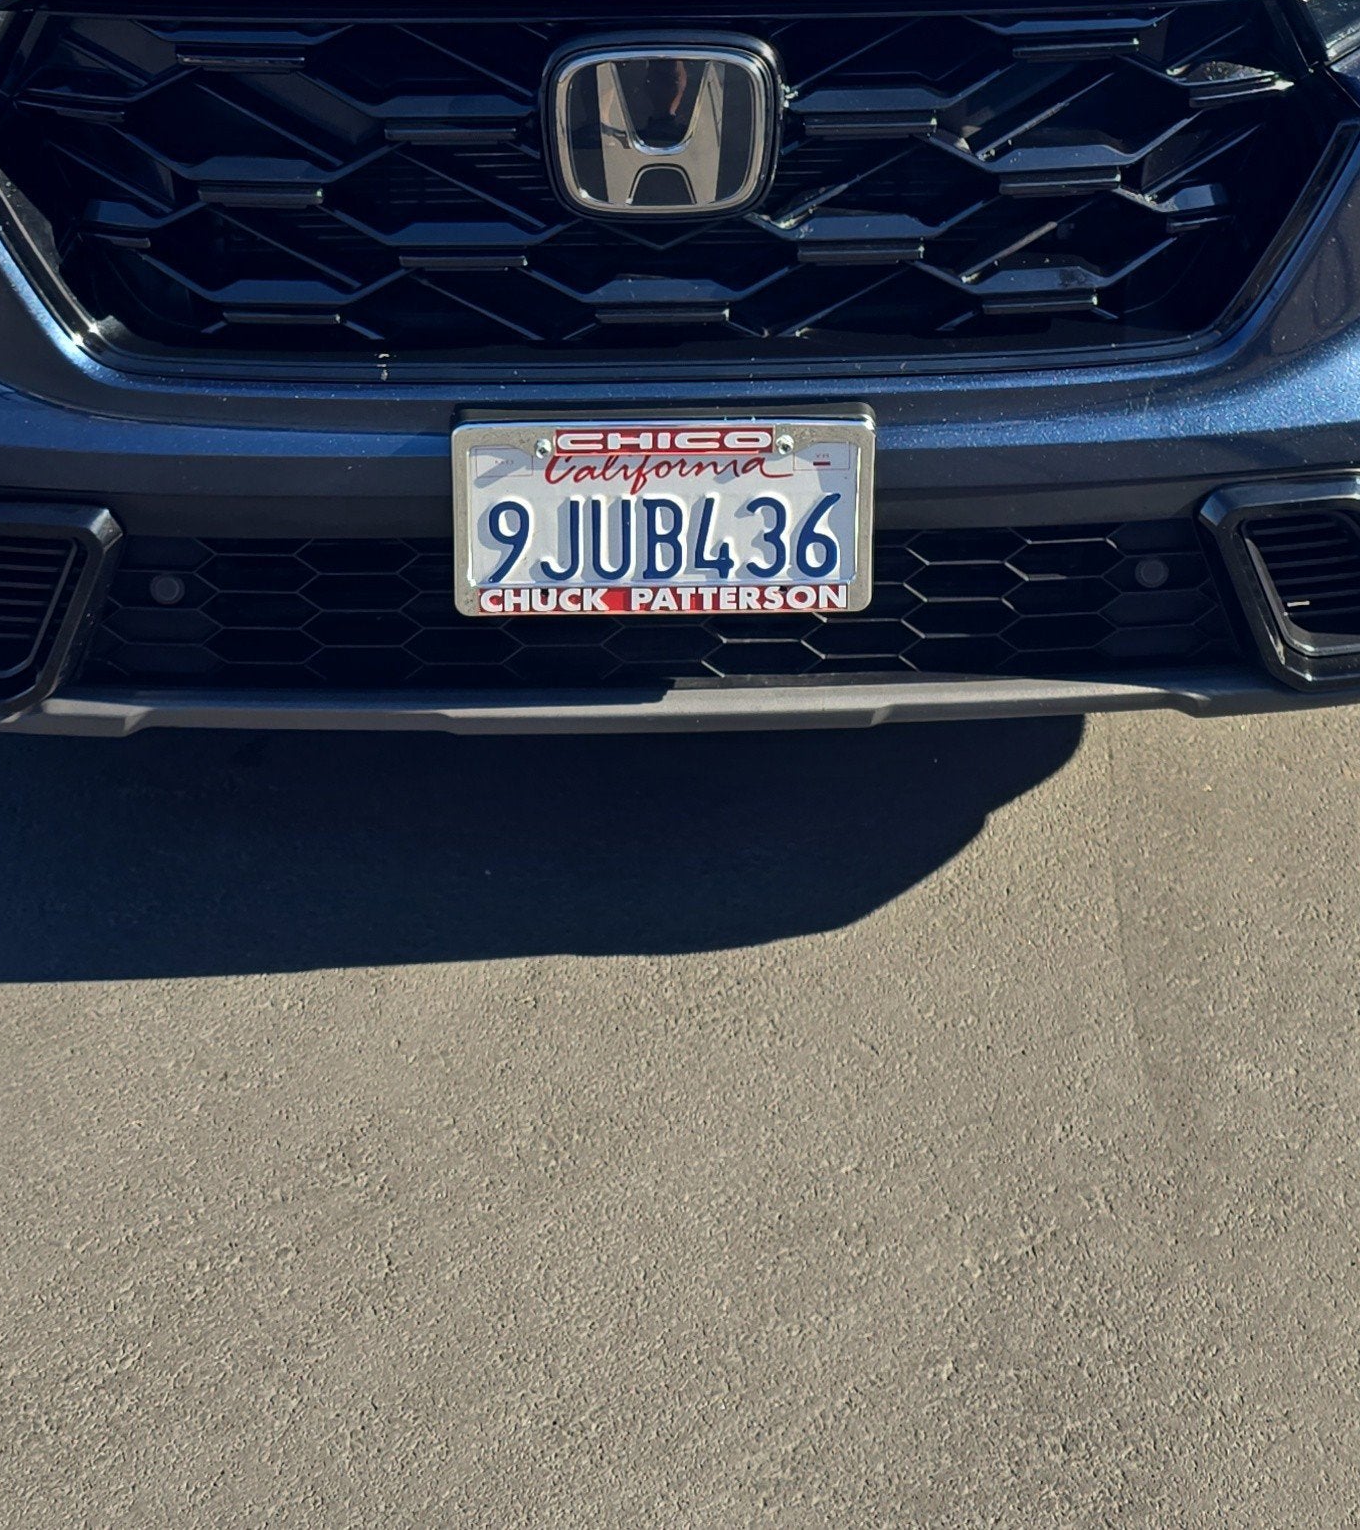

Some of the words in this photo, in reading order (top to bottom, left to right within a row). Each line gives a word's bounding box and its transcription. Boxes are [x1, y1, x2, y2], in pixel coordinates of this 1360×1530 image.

[556, 431, 773, 451] CHICO
[544, 455, 794, 496] California
[488, 492, 841, 583] 9JUB436
[480, 587, 610, 613] CHUCK
[631, 585, 847, 611] PATTERSON
